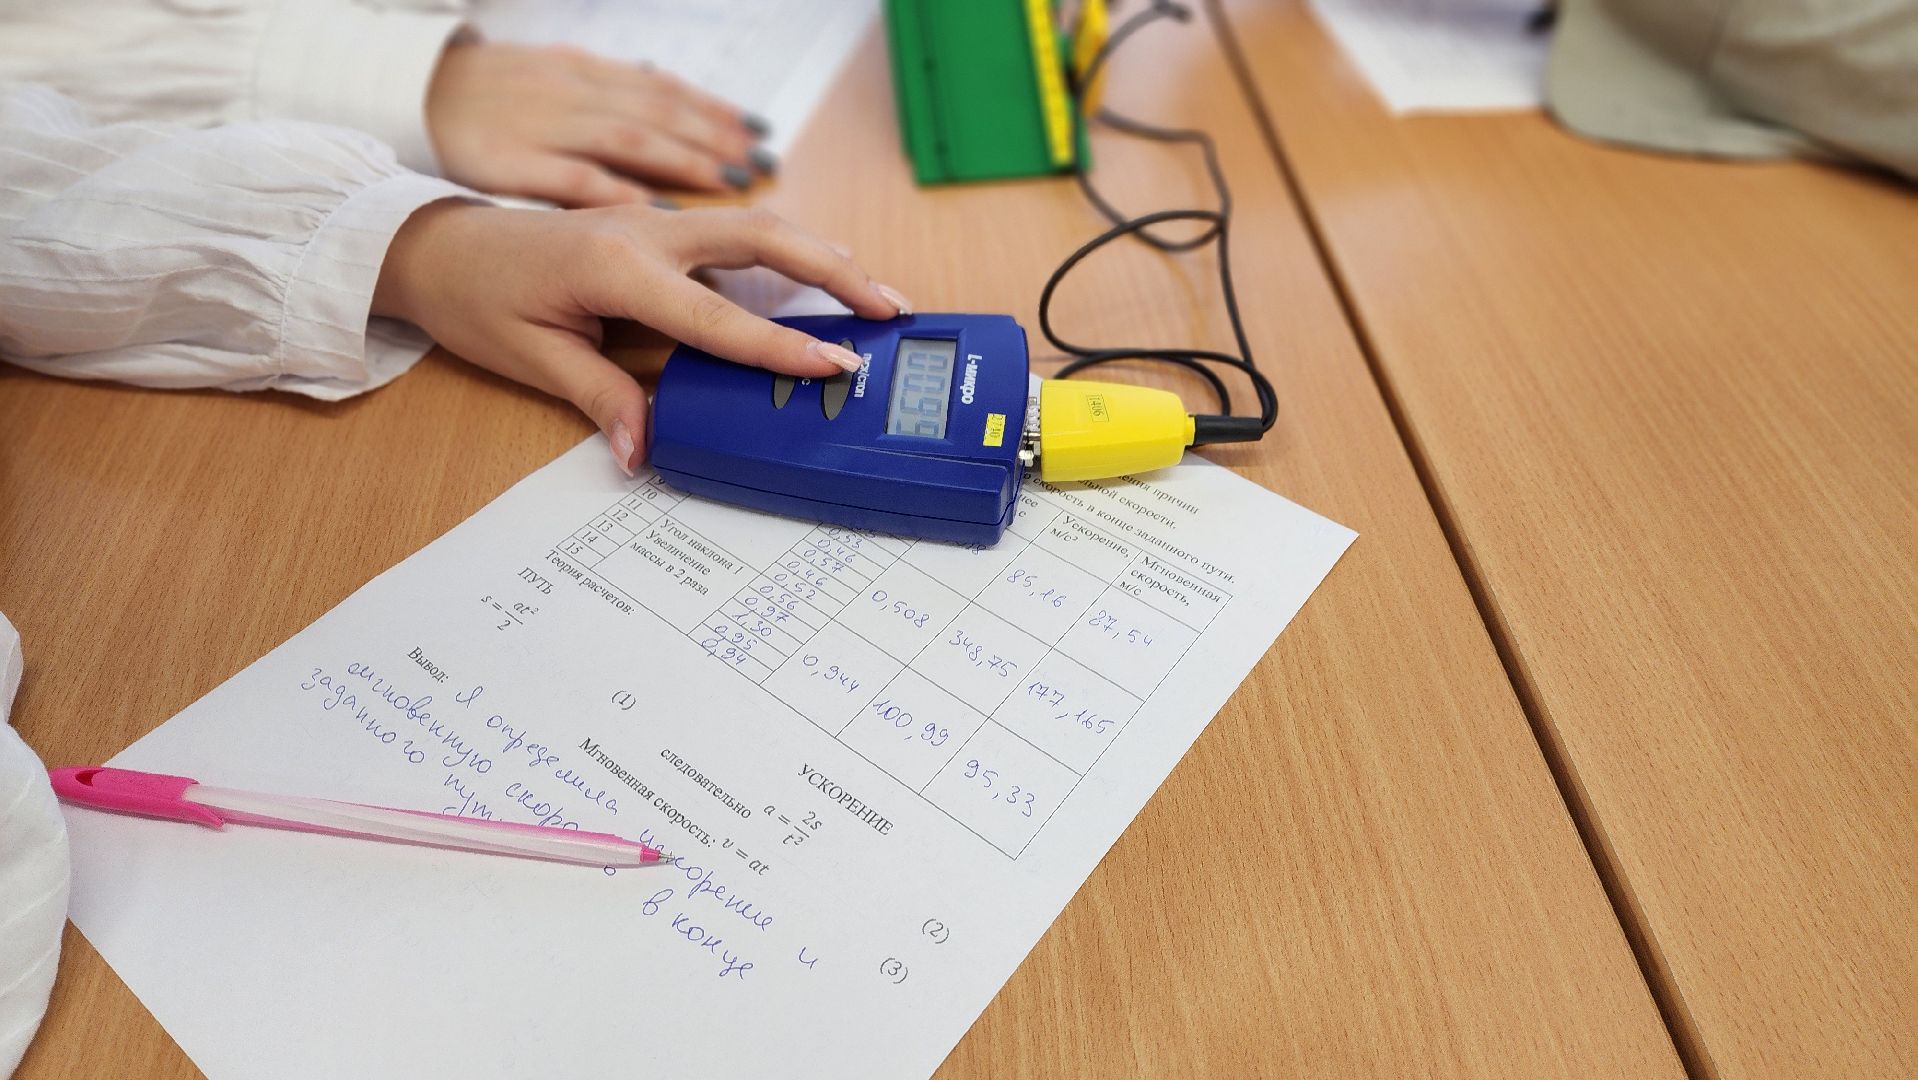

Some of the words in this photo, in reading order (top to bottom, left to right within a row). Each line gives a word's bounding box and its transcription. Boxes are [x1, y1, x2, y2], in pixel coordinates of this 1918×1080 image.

[642, 488, 658, 500] 10
[1118, 475, 1151, 491] ения
[611, 509, 629, 522] 12
[626, 499, 643, 511] 11
[1119, 496, 1176, 529] скорости.
[581, 531, 599, 543] 14
[596, 519, 614, 532] 13
[1033, 478, 1084, 508] скорость
[1096, 510, 1134, 532] конце
[1134, 528, 1199, 565] заданного
[1201, 561, 1235, 584] пути.
[1062, 516, 1130, 559] Ускорение,
[565, 542, 584, 555] 15
[629, 541, 666, 568] массы
[645, 529, 711, 576] Увеличение
[660, 519, 688, 541] Угол
[687, 537, 733, 571] наклона
[518, 567, 552, 595] ПУТЬ
[544, 549, 584, 580] Теория
[579, 577, 635, 616] расчетов:
[674, 569, 686, 579] 2
[679, 576, 709, 596] раза
[1119, 581, 1142, 597] м/с
[1130, 569, 1190, 607] скорость,
[1141, 556, 1223, 604] Мгновенная
[407, 646, 450, 683] Вывод:
[611, 690, 637, 712] (1)
[487, 714, 618, 816] определила
[578, 737, 656, 803] Мгновенная
[654, 795, 716, 848] скорость:
[660, 747, 752, 819] следовательно
[964, 759, 1036, 818] 95,33
[798, 763, 895, 836] УСКОРЕНИЕ
[642, 888, 674, 916] в
[671, 912, 754, 980] конце
[921, 918, 950, 944] (2)
[879, 957, 909, 984] (3)
